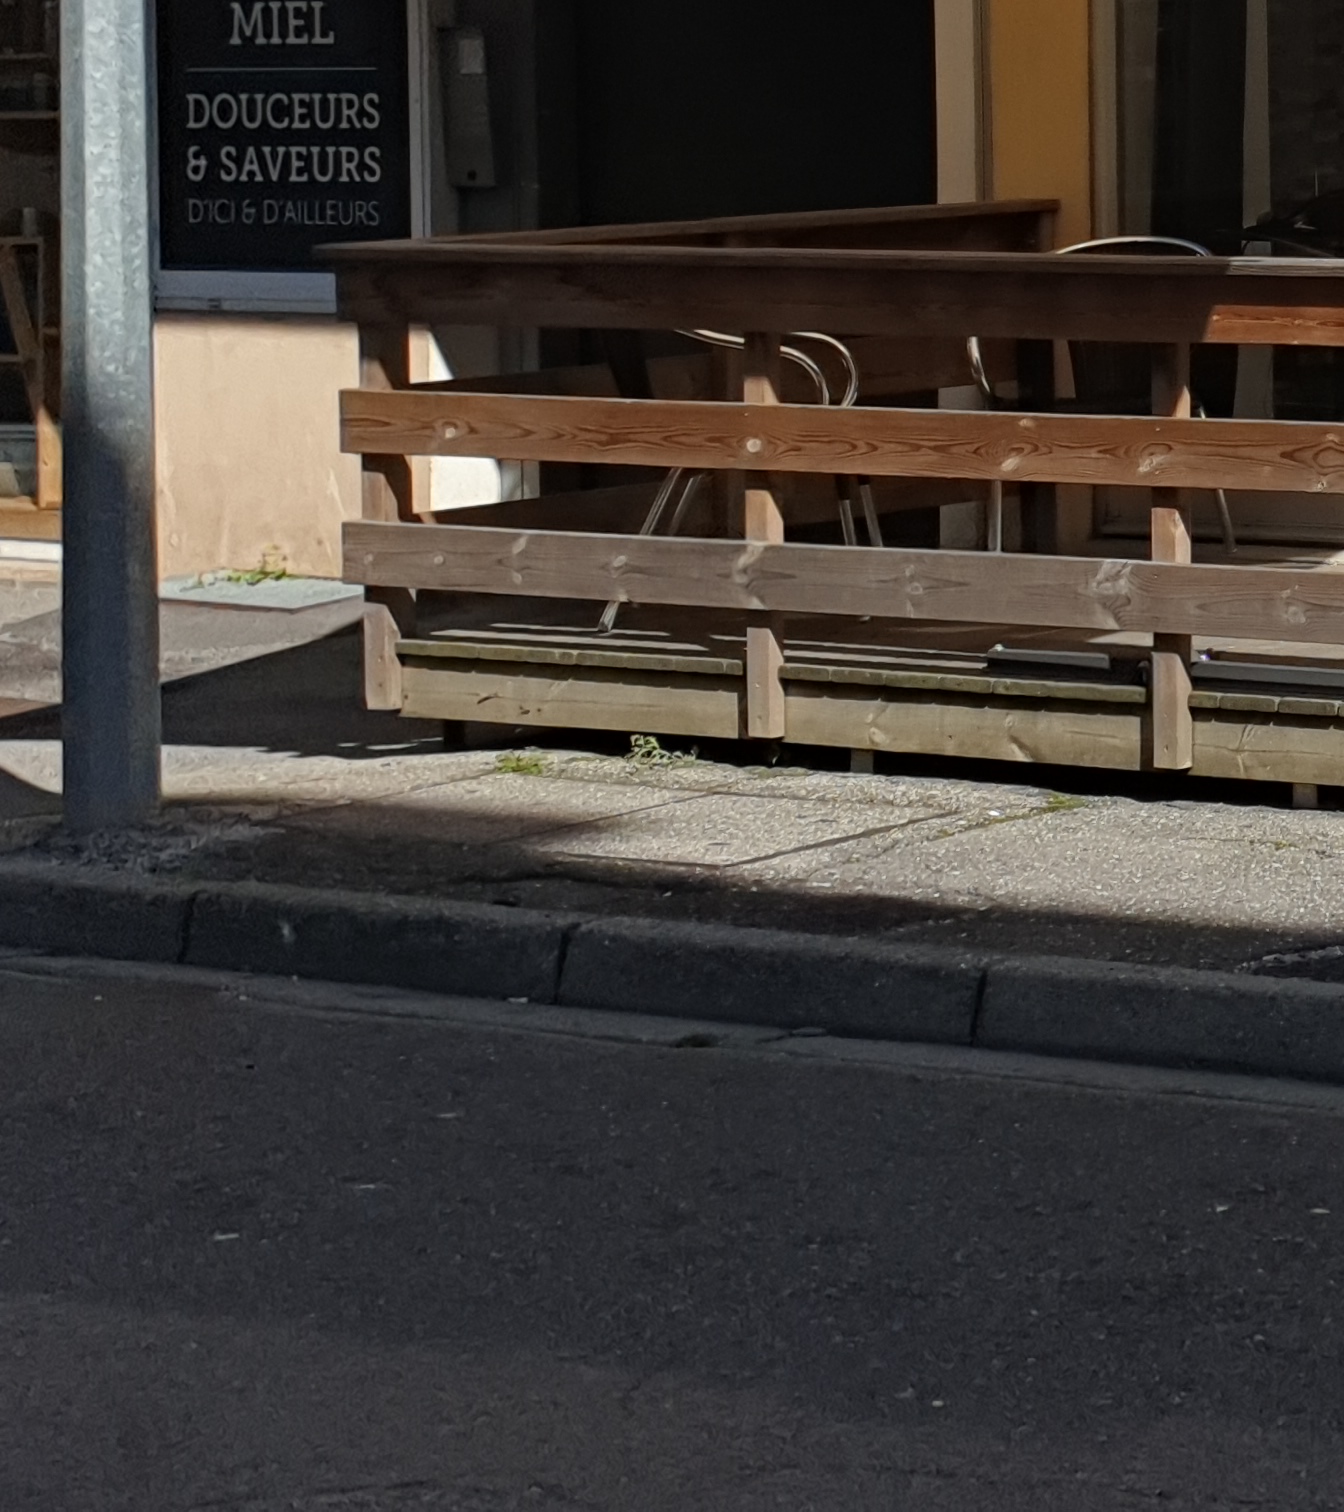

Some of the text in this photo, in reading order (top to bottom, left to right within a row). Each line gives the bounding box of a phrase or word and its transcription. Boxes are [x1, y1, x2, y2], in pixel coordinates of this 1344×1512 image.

[228, 0, 334, 46] MIEL
[186, 93, 380, 130] DOUCEURS
[186, 145, 382, 184] & SAVEURS
[187, 198, 380, 227] D'ICI & D'AILLEURS
